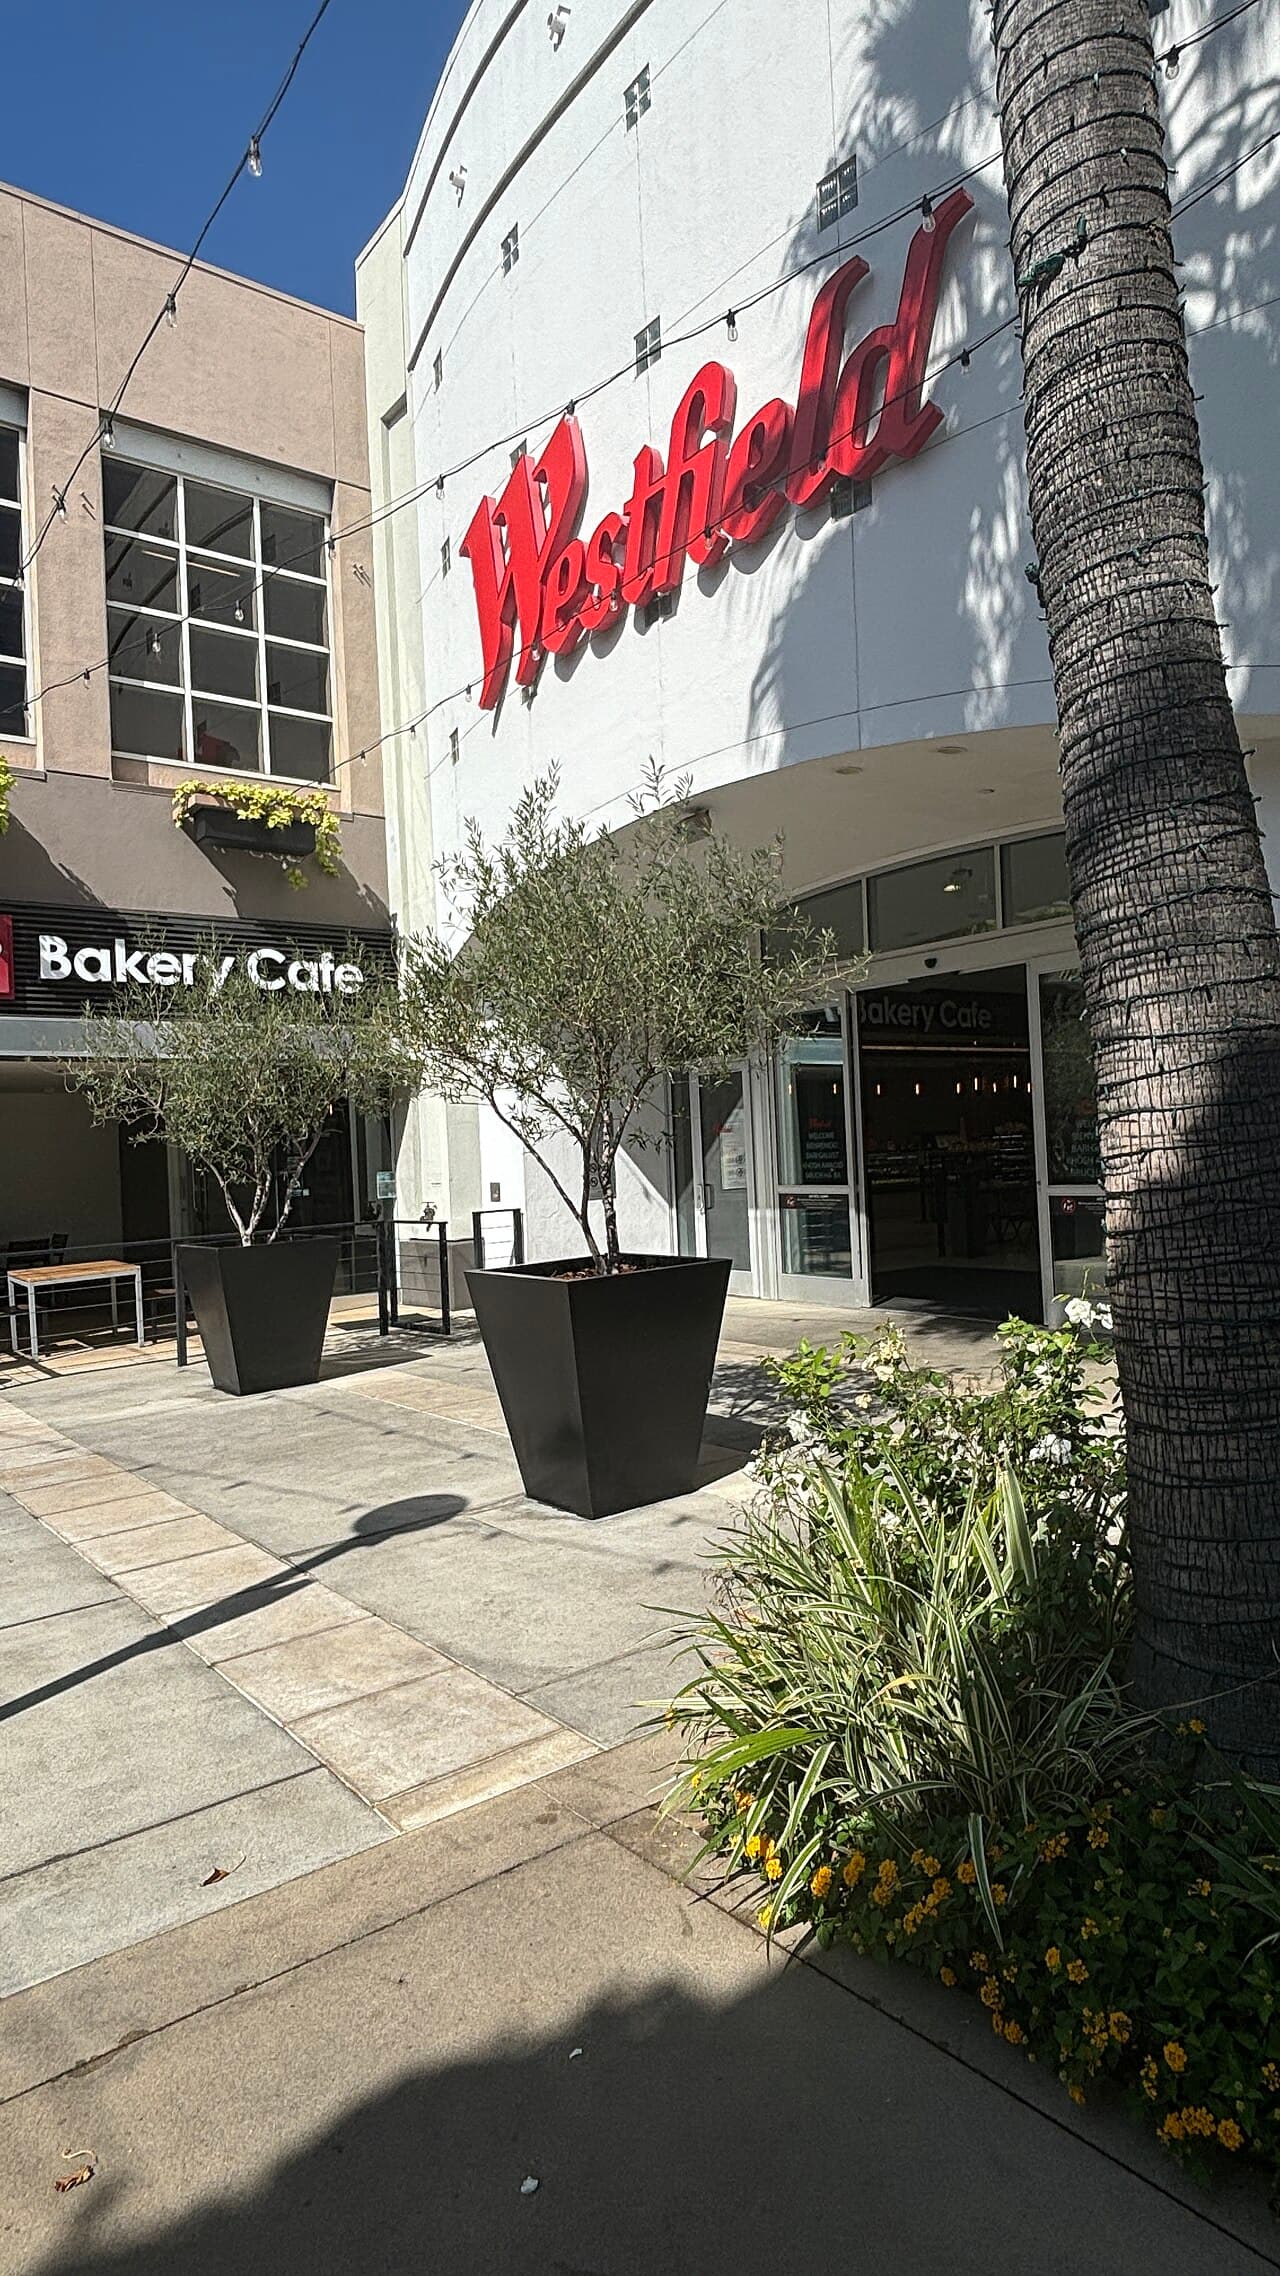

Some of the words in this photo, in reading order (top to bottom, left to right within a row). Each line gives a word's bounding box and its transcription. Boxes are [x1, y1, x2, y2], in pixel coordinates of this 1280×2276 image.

[459, 187, 974, 710] Westfield
[38, 934, 235, 996] Bakery
[248, 948, 364, 994] Cafe
[939, 1000, 992, 1030] Cafe
